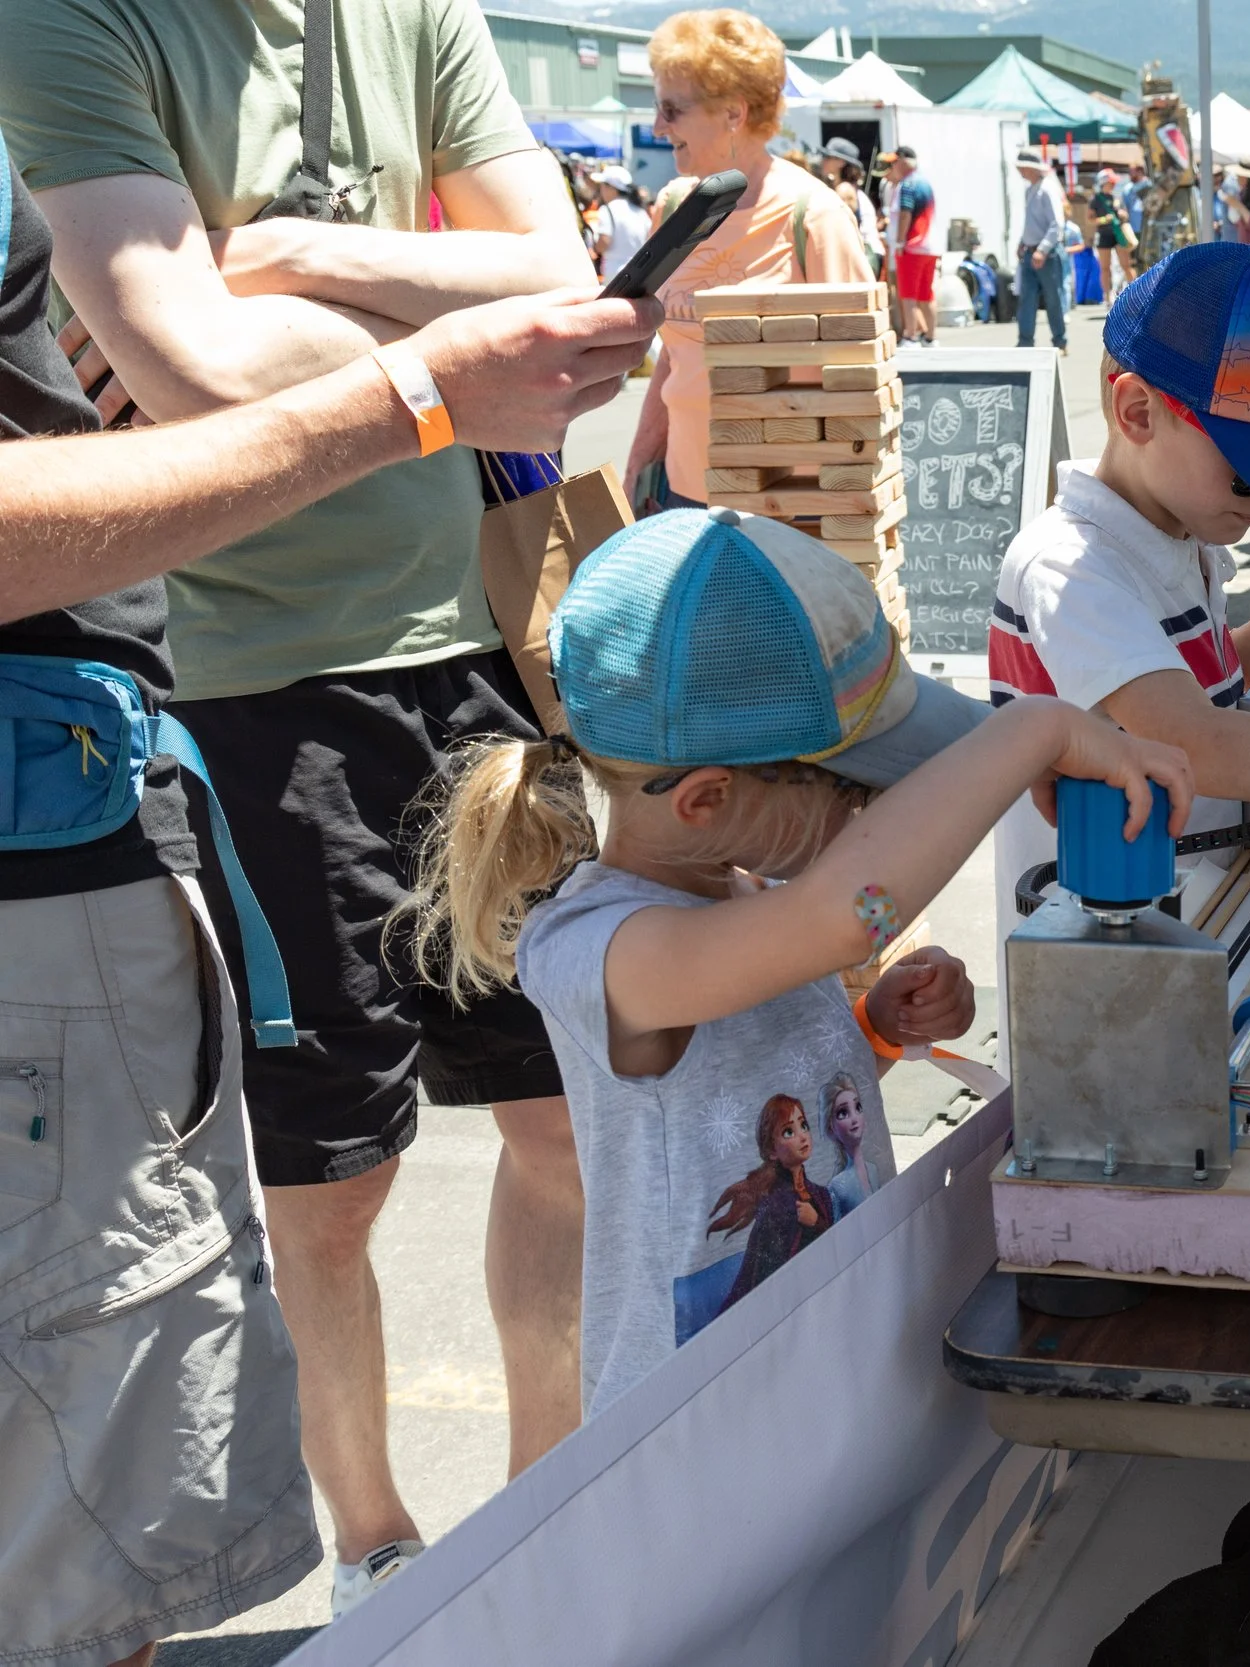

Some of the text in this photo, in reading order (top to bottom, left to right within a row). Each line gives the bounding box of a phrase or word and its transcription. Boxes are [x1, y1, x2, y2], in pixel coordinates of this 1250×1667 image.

[899, 516, 1014, 548] RAZY DOG?
[899, 555, 940, 573] OINT
